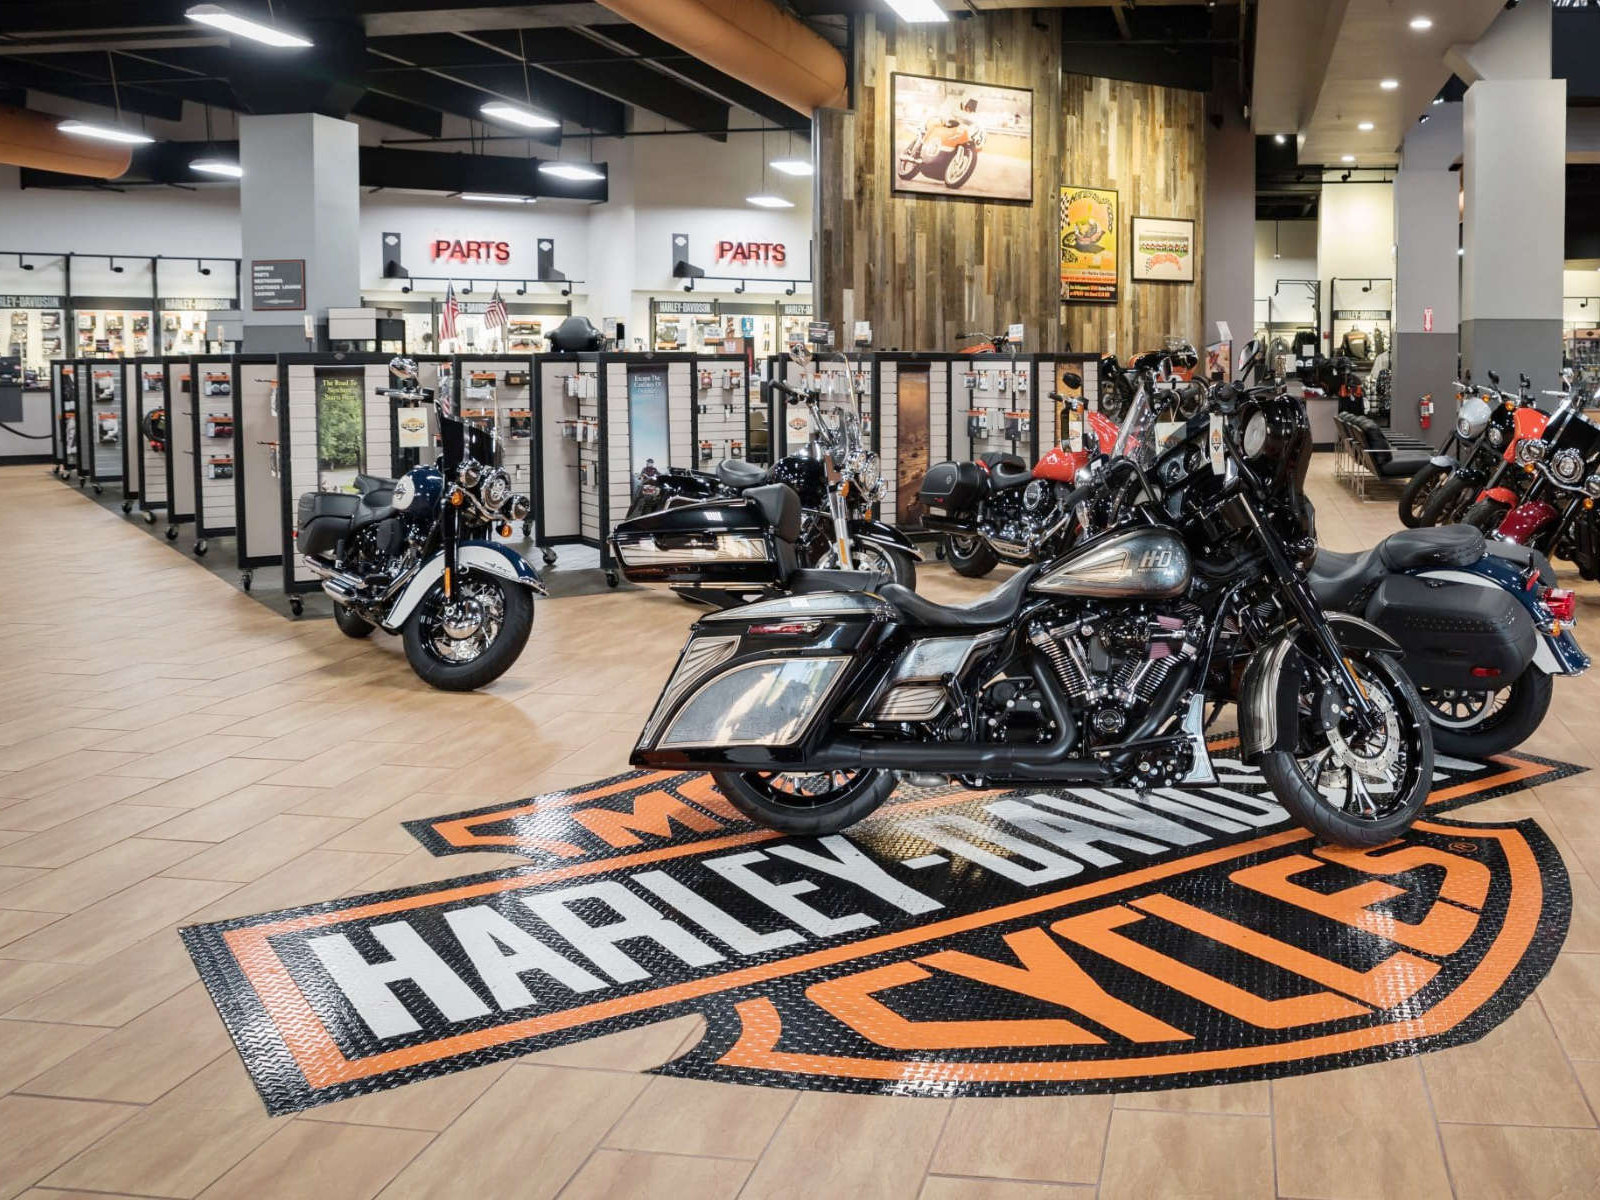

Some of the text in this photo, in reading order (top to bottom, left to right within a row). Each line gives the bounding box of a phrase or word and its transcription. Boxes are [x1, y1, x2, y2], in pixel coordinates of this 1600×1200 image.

[433, 240, 510, 262] PARTS
[716, 240, 786, 263] PARTS
[659, 302, 711, 313] HARLEY-DAVIDSON
[1140, 551, 1172, 568] H-D
[306, 752, 1488, 1040] HARLEY-DAVID
[804, 839, 1492, 1050] CYCLES
